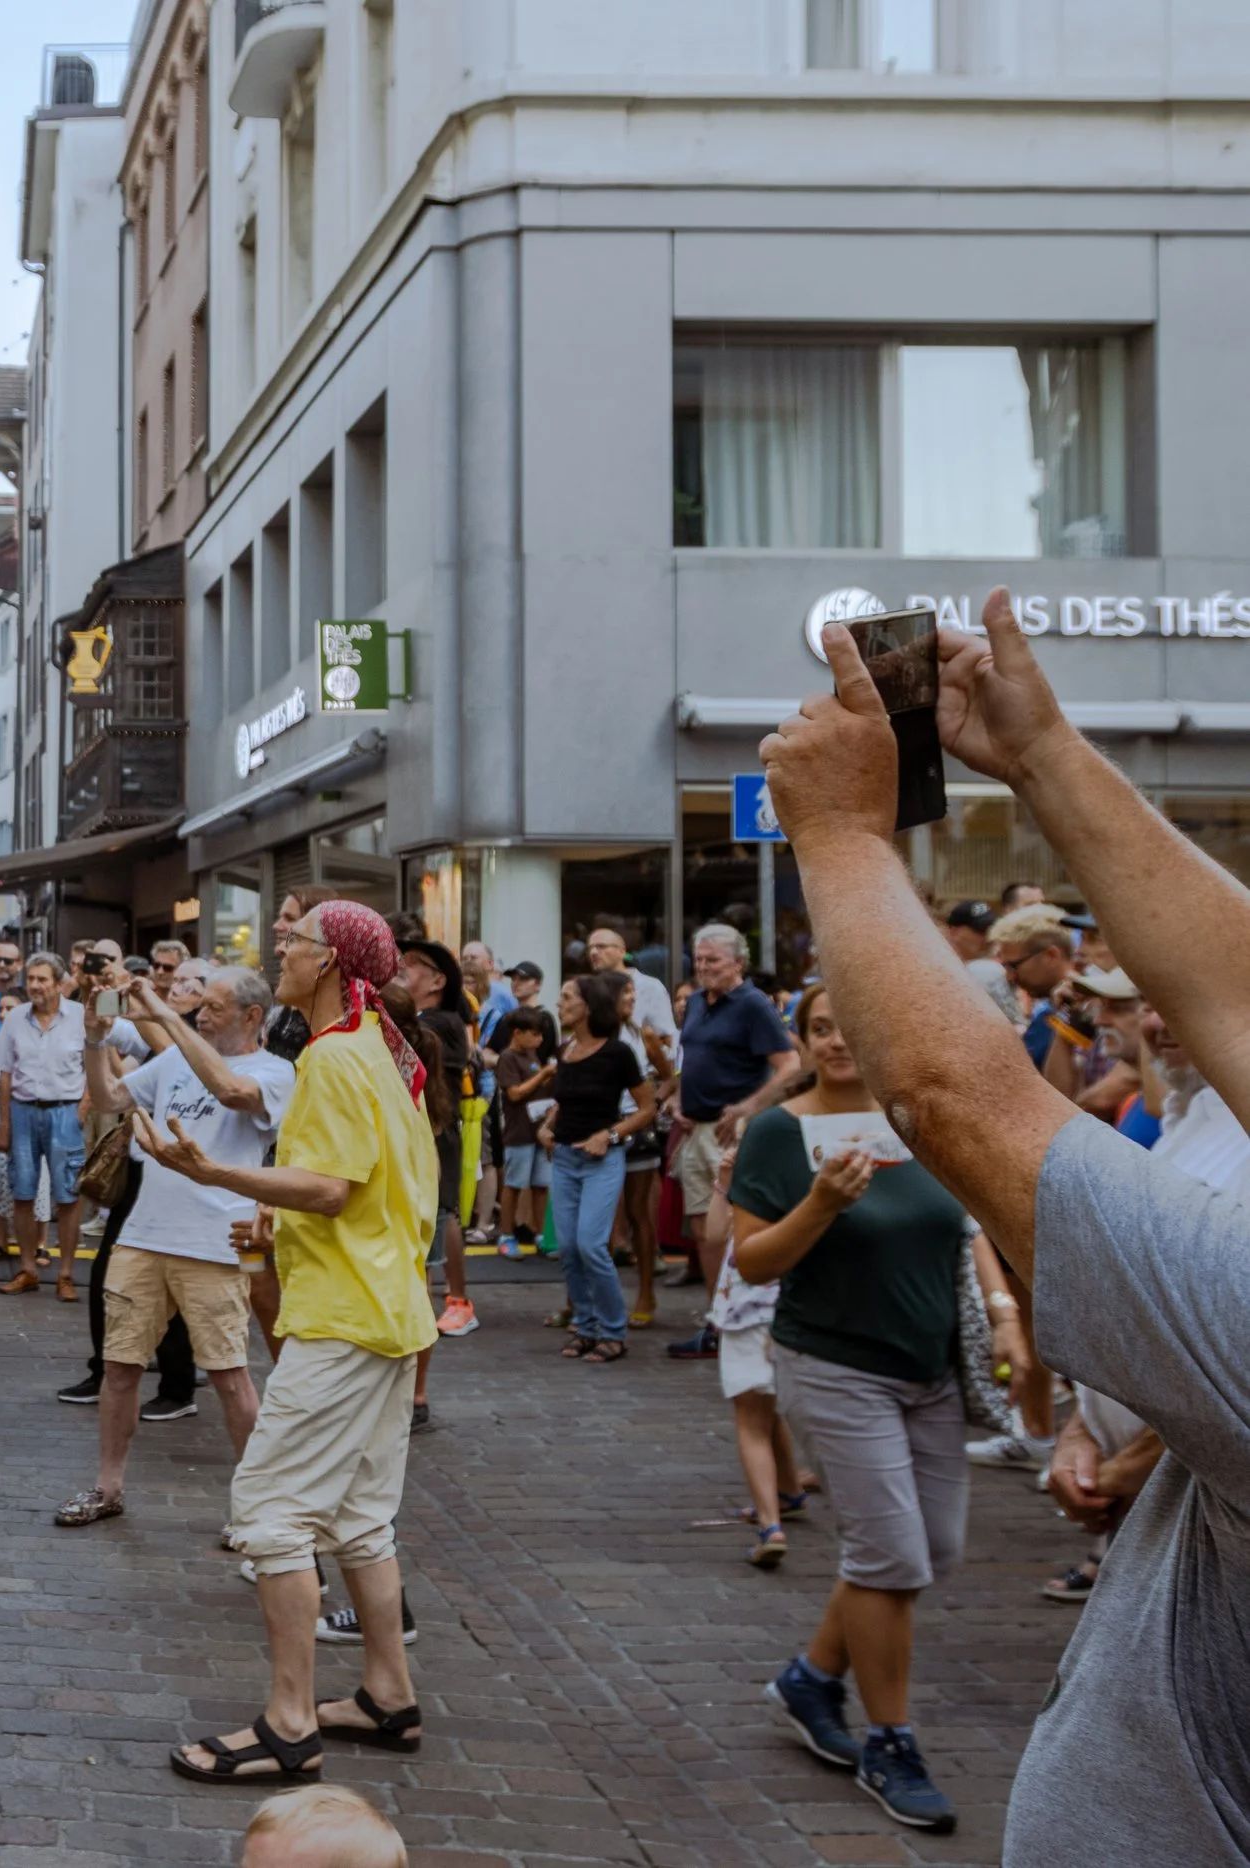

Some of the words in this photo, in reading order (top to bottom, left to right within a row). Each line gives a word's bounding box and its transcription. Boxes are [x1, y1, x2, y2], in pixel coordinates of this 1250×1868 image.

[907, 594, 1049, 636] ALIS
[1059, 596, 1146, 637] DES
[323, 624, 372, 641] PALAIS
[323, 637, 353, 656] DES
